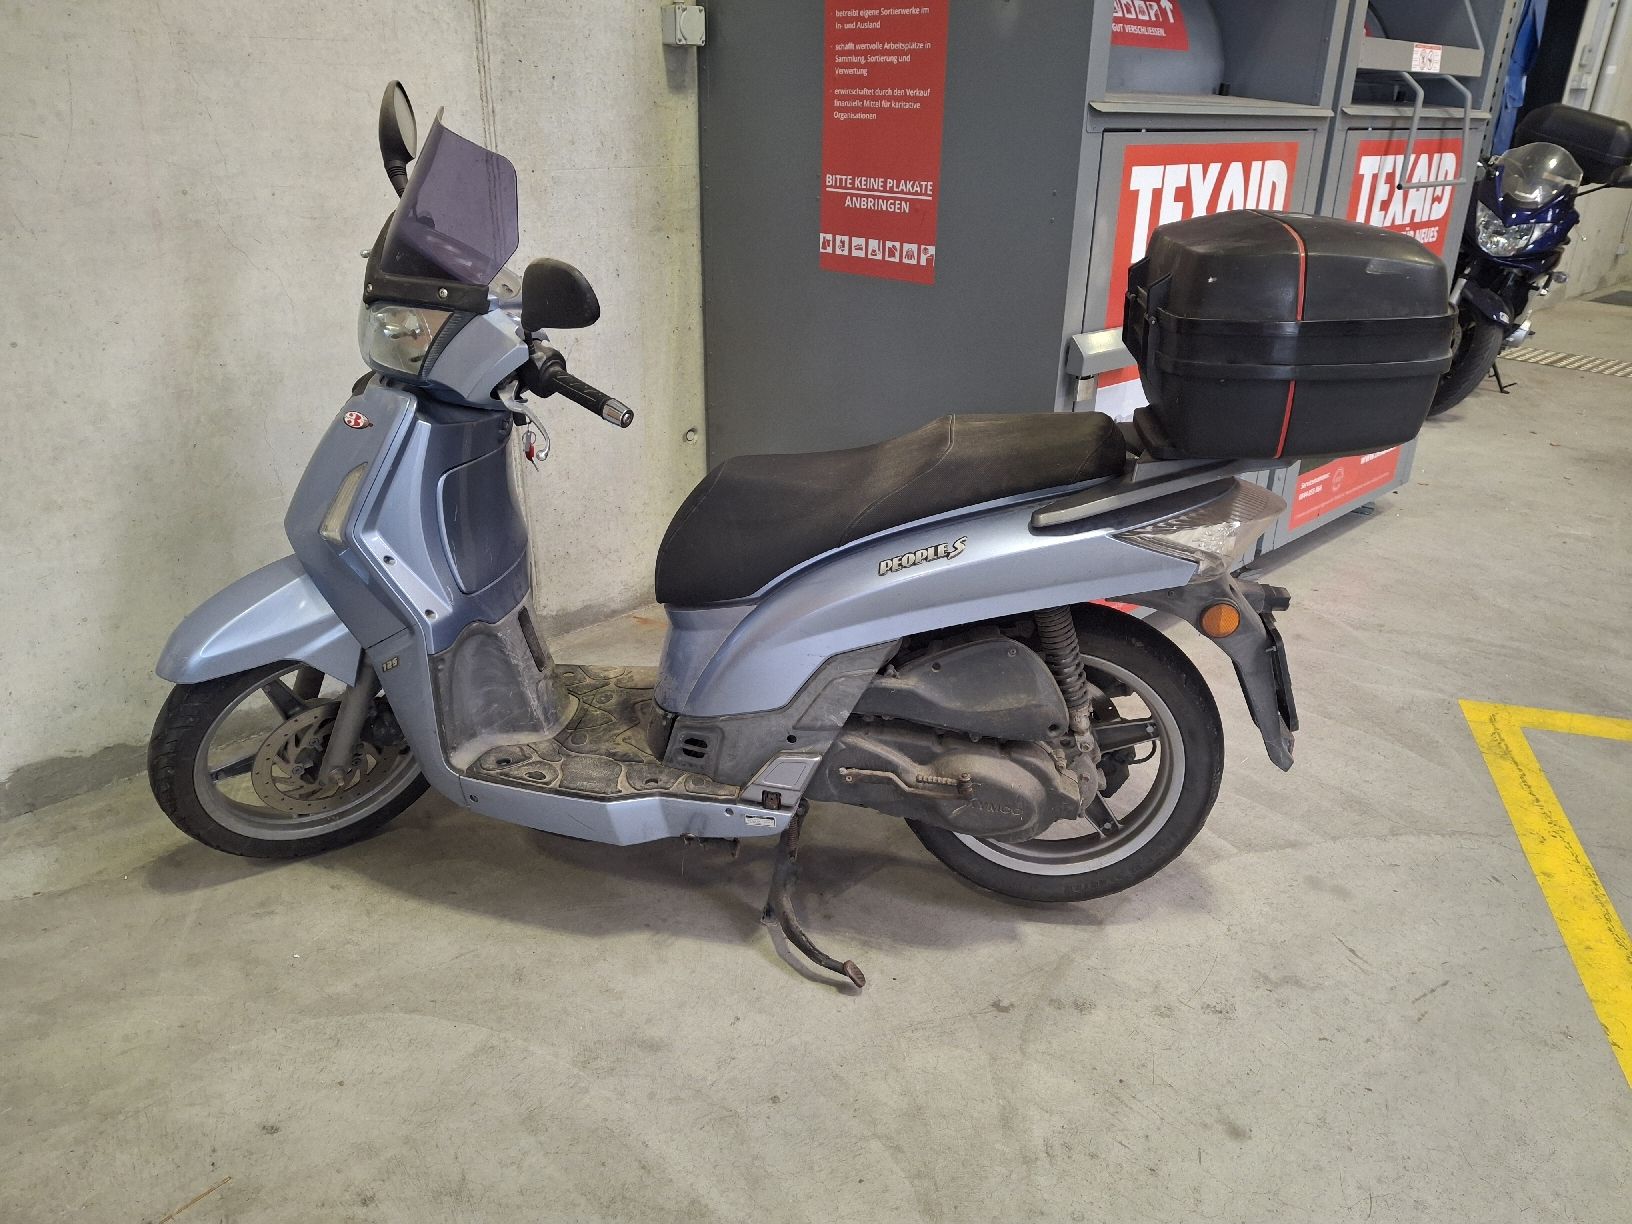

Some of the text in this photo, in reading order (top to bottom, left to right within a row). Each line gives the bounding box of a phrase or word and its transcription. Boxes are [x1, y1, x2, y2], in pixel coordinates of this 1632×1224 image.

[836, 9, 859, 17] betreibt
[860, 9, 879, 18] eigene
[880, 7, 920, 16] Sortierwerke
[844, 21, 856, 29] und
[856, 21, 881, 29] Ausland
[835, 42, 855, 51] schafft
[856, 42, 883, 50] wertvolle
[884, 42, 924, 51] Arbeitsplätze
[835, 54, 911, 64] Sammlung, Sortierung und
[834, 67, 868, 76] Verwertung
[834, 87, 931, 97] erwirtschaftet durch den Verkauf
[834, 99, 921, 109] finanzielle Mittel für karitative
[833, 111, 877, 120] Organisationen
[826, 173, 933, 194] BITTE KEINE PLAKATE
[1356, 152, 1456, 227] TEXAID
[845, 196, 910, 213] ANBRINGEN
